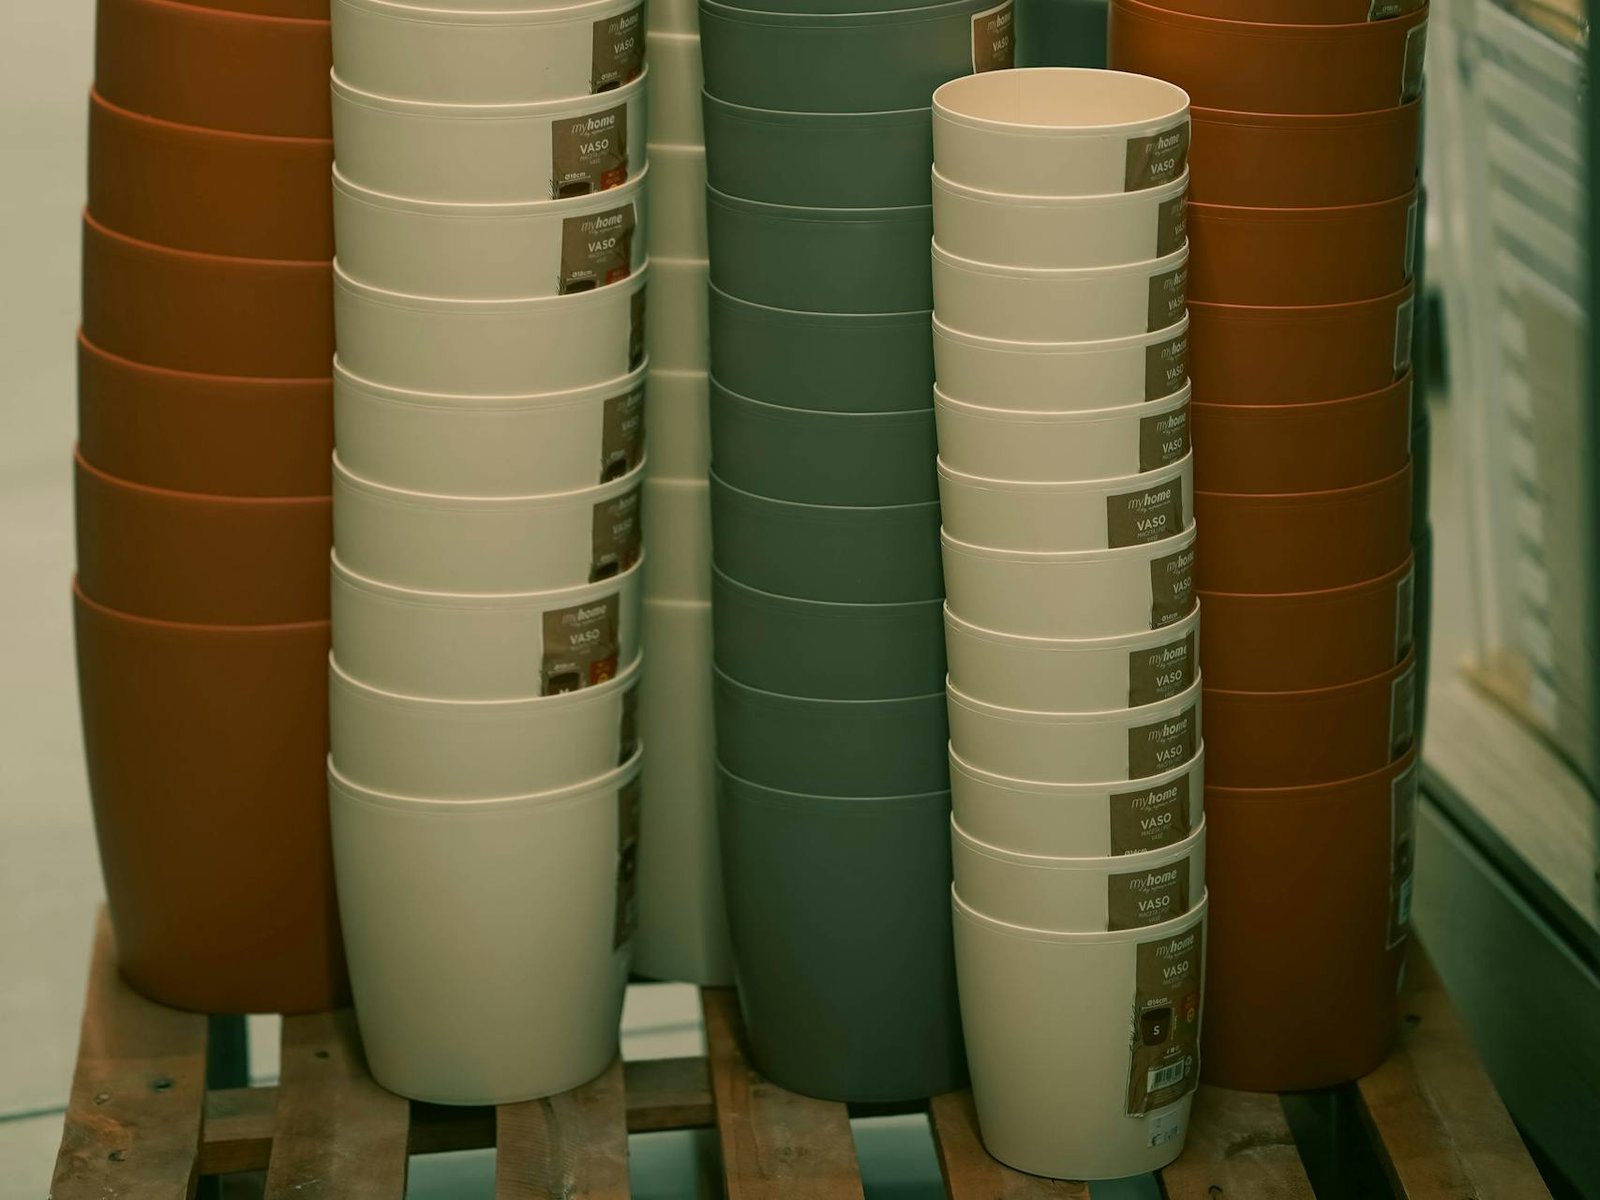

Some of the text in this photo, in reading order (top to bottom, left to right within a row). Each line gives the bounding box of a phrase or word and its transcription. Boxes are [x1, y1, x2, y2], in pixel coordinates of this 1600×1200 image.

[614, 37, 634, 54] VASO
[571, 115, 615, 136] myhome
[580, 139, 609, 154] VASO
[1151, 158, 1175, 175] VASO
[582, 214, 623, 234] myhome
[588, 238, 616, 253] VASO
[1167, 363, 1184, 380] VASO
[1162, 438, 1183, 453] VASO
[1128, 489, 1171, 511] myhome
[1137, 514, 1166, 531] VASO
[1173, 577, 1191, 593] VASO
[570, 629, 600, 645] VASO
[1149, 645, 1187, 666] myhome
[1156, 669, 1182, 686] VASO
[1148, 719, 1188, 742] myhome
[1156, 745, 1182, 762] VASO
[1131, 787, 1177, 810] myhome
[1140, 813, 1171, 829] VASO
[1129, 870, 1177, 891] myhome
[1138, 895, 1170, 911] VASO
[1163, 961, 1189, 978] VASO
[1152, 1025, 1161, 1036] S
